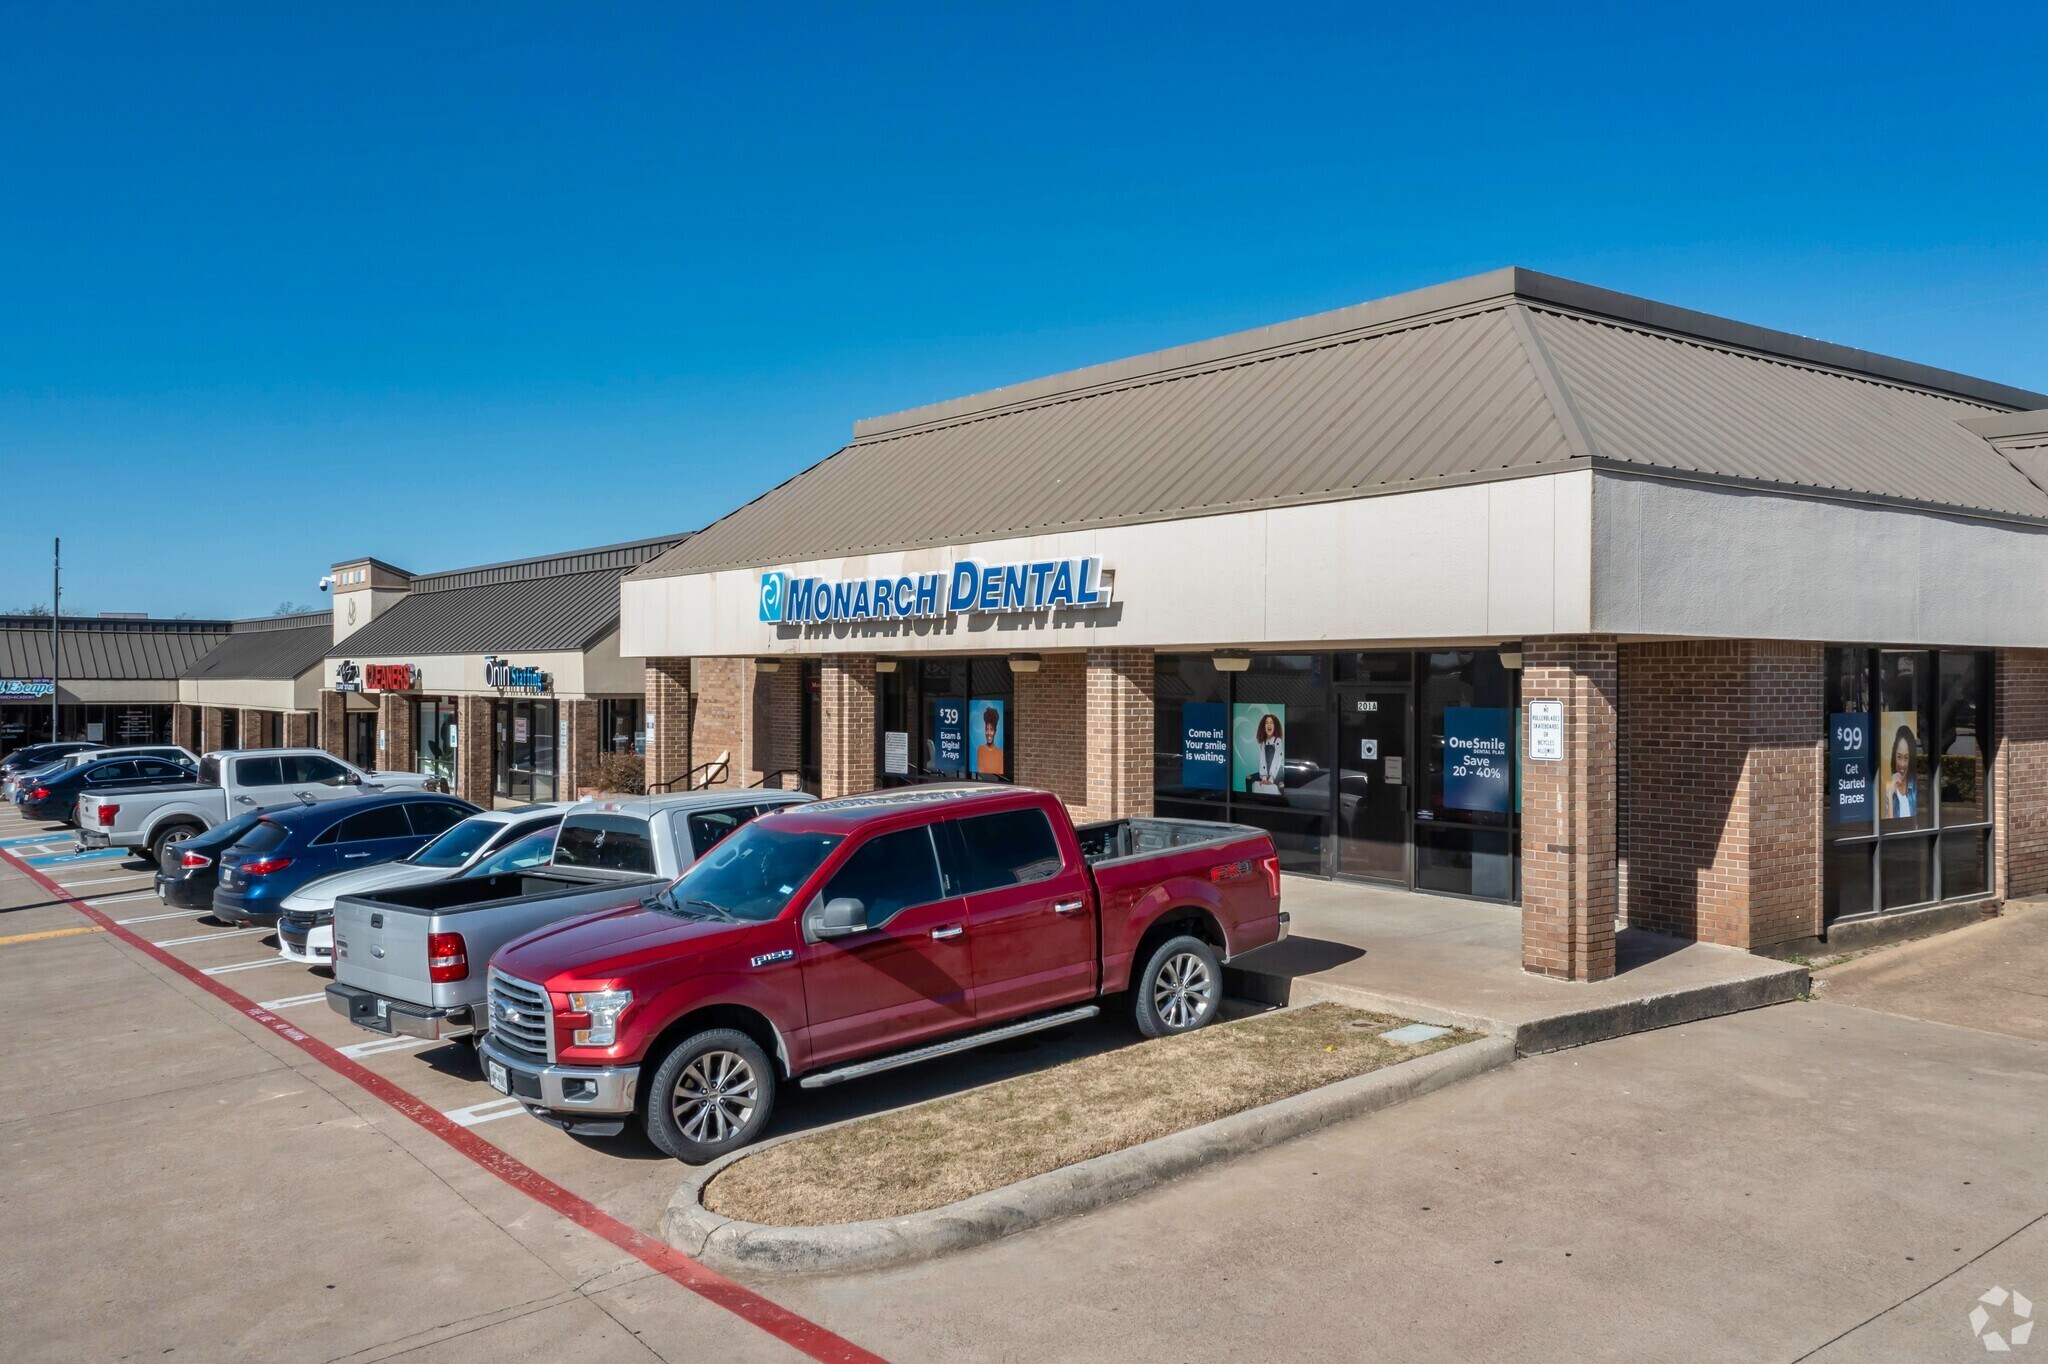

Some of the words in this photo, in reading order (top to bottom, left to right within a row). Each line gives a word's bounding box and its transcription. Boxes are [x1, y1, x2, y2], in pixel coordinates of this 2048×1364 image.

[786, 574, 940, 622] MONARCH
[949, 557, 1101, 612] DENTAL
[366, 663, 411, 691] CLEANERS
[511, 666, 542, 693] Staffing
[6, 681, 54, 697] Escape
[1358, 702, 1377, 711] 201A
[940, 708, 959, 724] $39
[940, 732, 956, 740] Exam
[956, 732, 961, 740] &
[1188, 728, 1212, 738] Come
[1213, 728, 1224, 739] in!
[1837, 727, 1862, 750] $99
[941, 741, 960, 751] Digital
[1185, 740, 1204, 749] Your
[1204, 741, 1227, 750] smile
[1449, 736, 1505, 750] OneSmile
[942, 750, 960, 760] X-rays
[1185, 751, 1193, 760] is
[1193, 752, 1227, 764] waiting.
[1463, 755, 1490, 767] Save
[1452, 766, 1467, 777] 20
[1476, 767, 1501, 779] 40%
[1845, 763, 1859, 775] Get
[1838, 777, 1866, 790] Started
[1839, 793, 1865, 805] Braces
[1211, 860, 1252, 882] FX4
